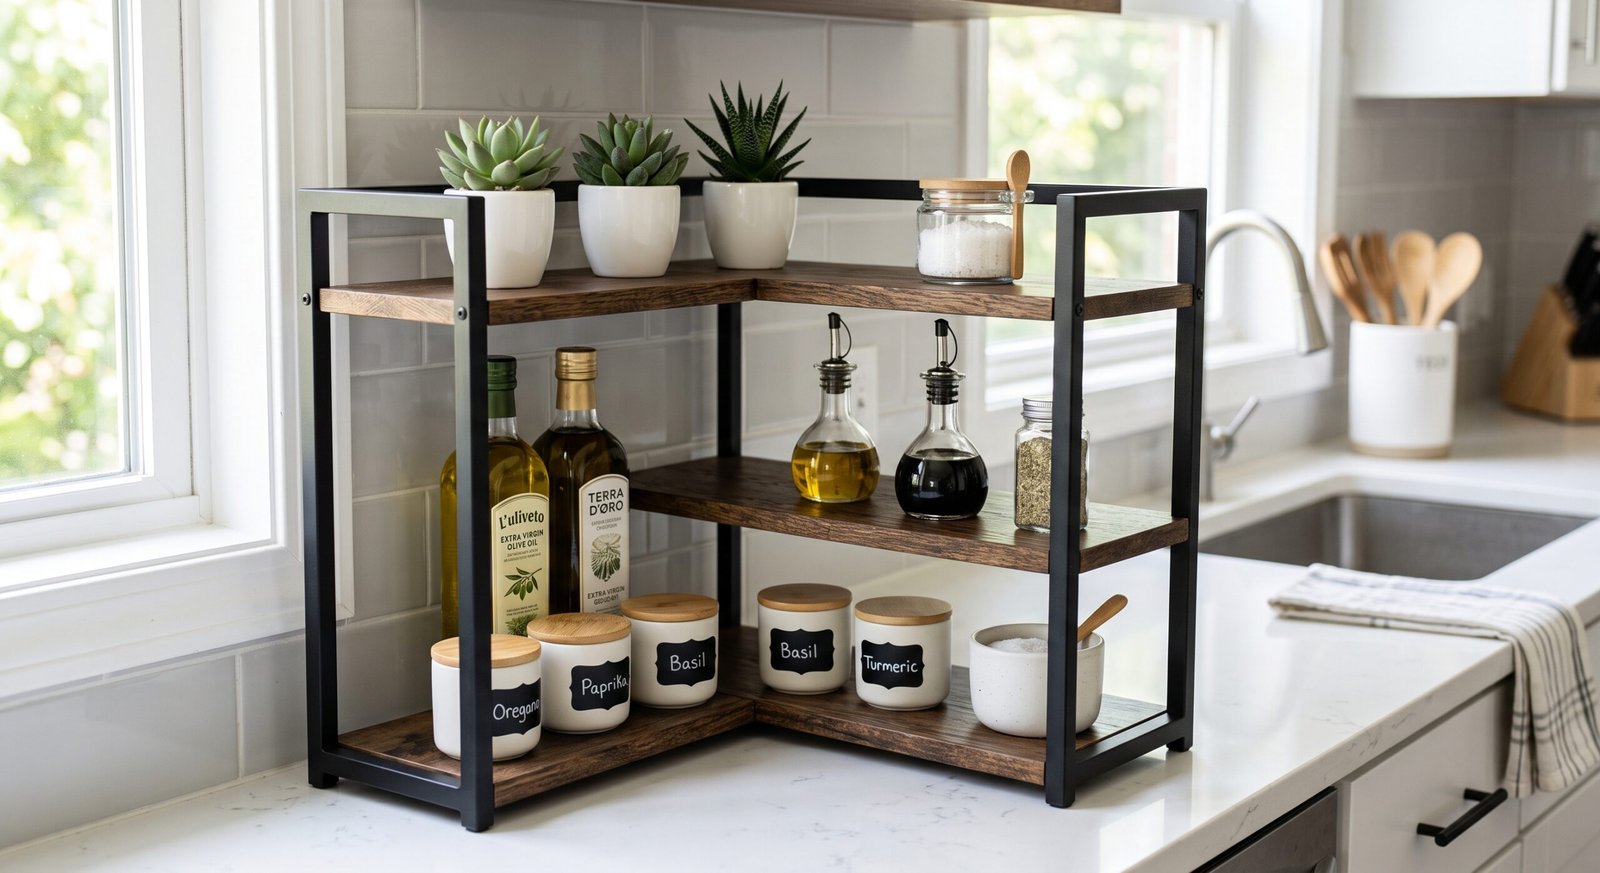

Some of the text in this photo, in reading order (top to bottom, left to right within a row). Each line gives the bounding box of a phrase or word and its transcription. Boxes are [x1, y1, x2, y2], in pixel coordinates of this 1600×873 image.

[588, 488, 624, 503] TERRA
[499, 509, 545, 530] L'uliveto
[500, 529, 544, 543] EXTRA VIRGIN
[507, 539, 538, 550] OLIVE OIL
[587, 585, 625, 599] EXTRA VIRGIN
[780, 642, 818, 659] Basil
[670, 652, 706, 672] Basil
[863, 654, 918, 673] Turmeric
[493, 699, 540, 723] Oregano
